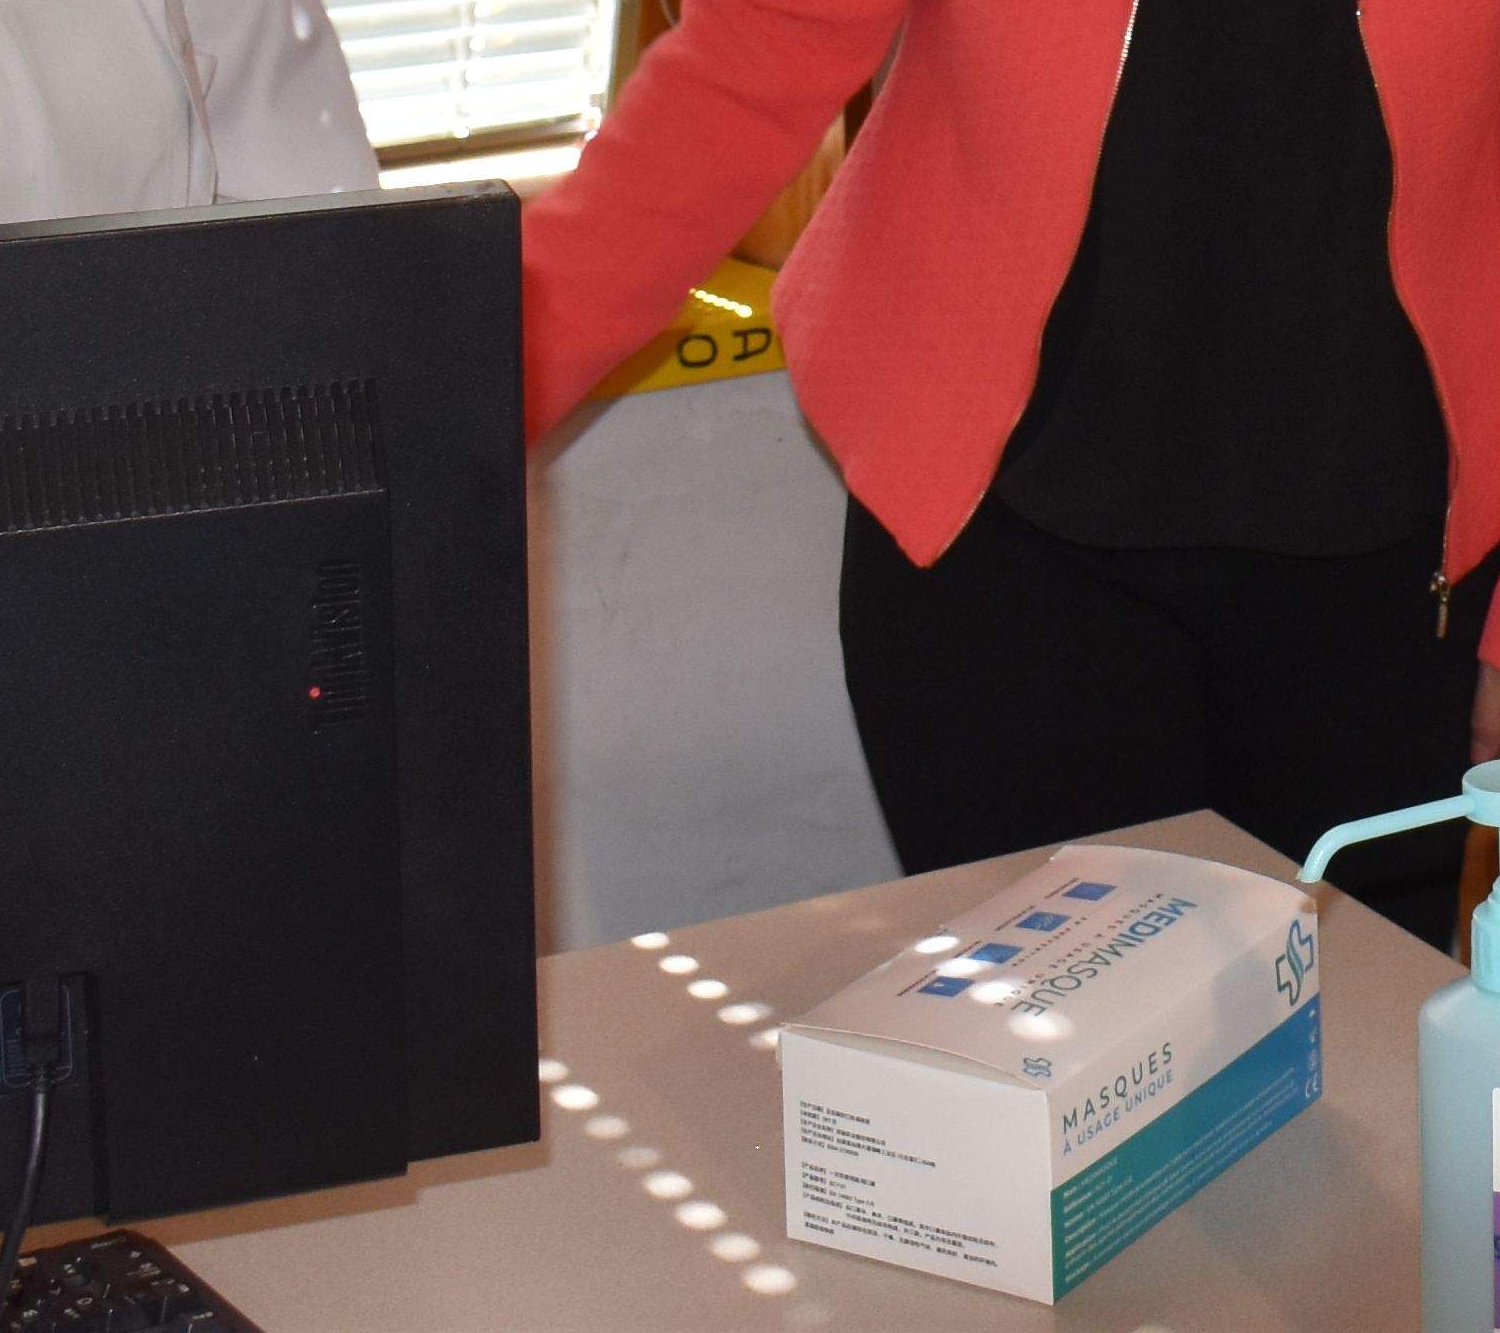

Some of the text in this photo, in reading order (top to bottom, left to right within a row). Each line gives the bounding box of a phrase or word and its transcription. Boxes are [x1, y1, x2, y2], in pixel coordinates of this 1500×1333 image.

[1062, 1041, 1174, 1135] MASQUES
[1077, 1107, 1121, 1146] USAGE
[1125, 1068, 1174, 1113] UNIQUE
